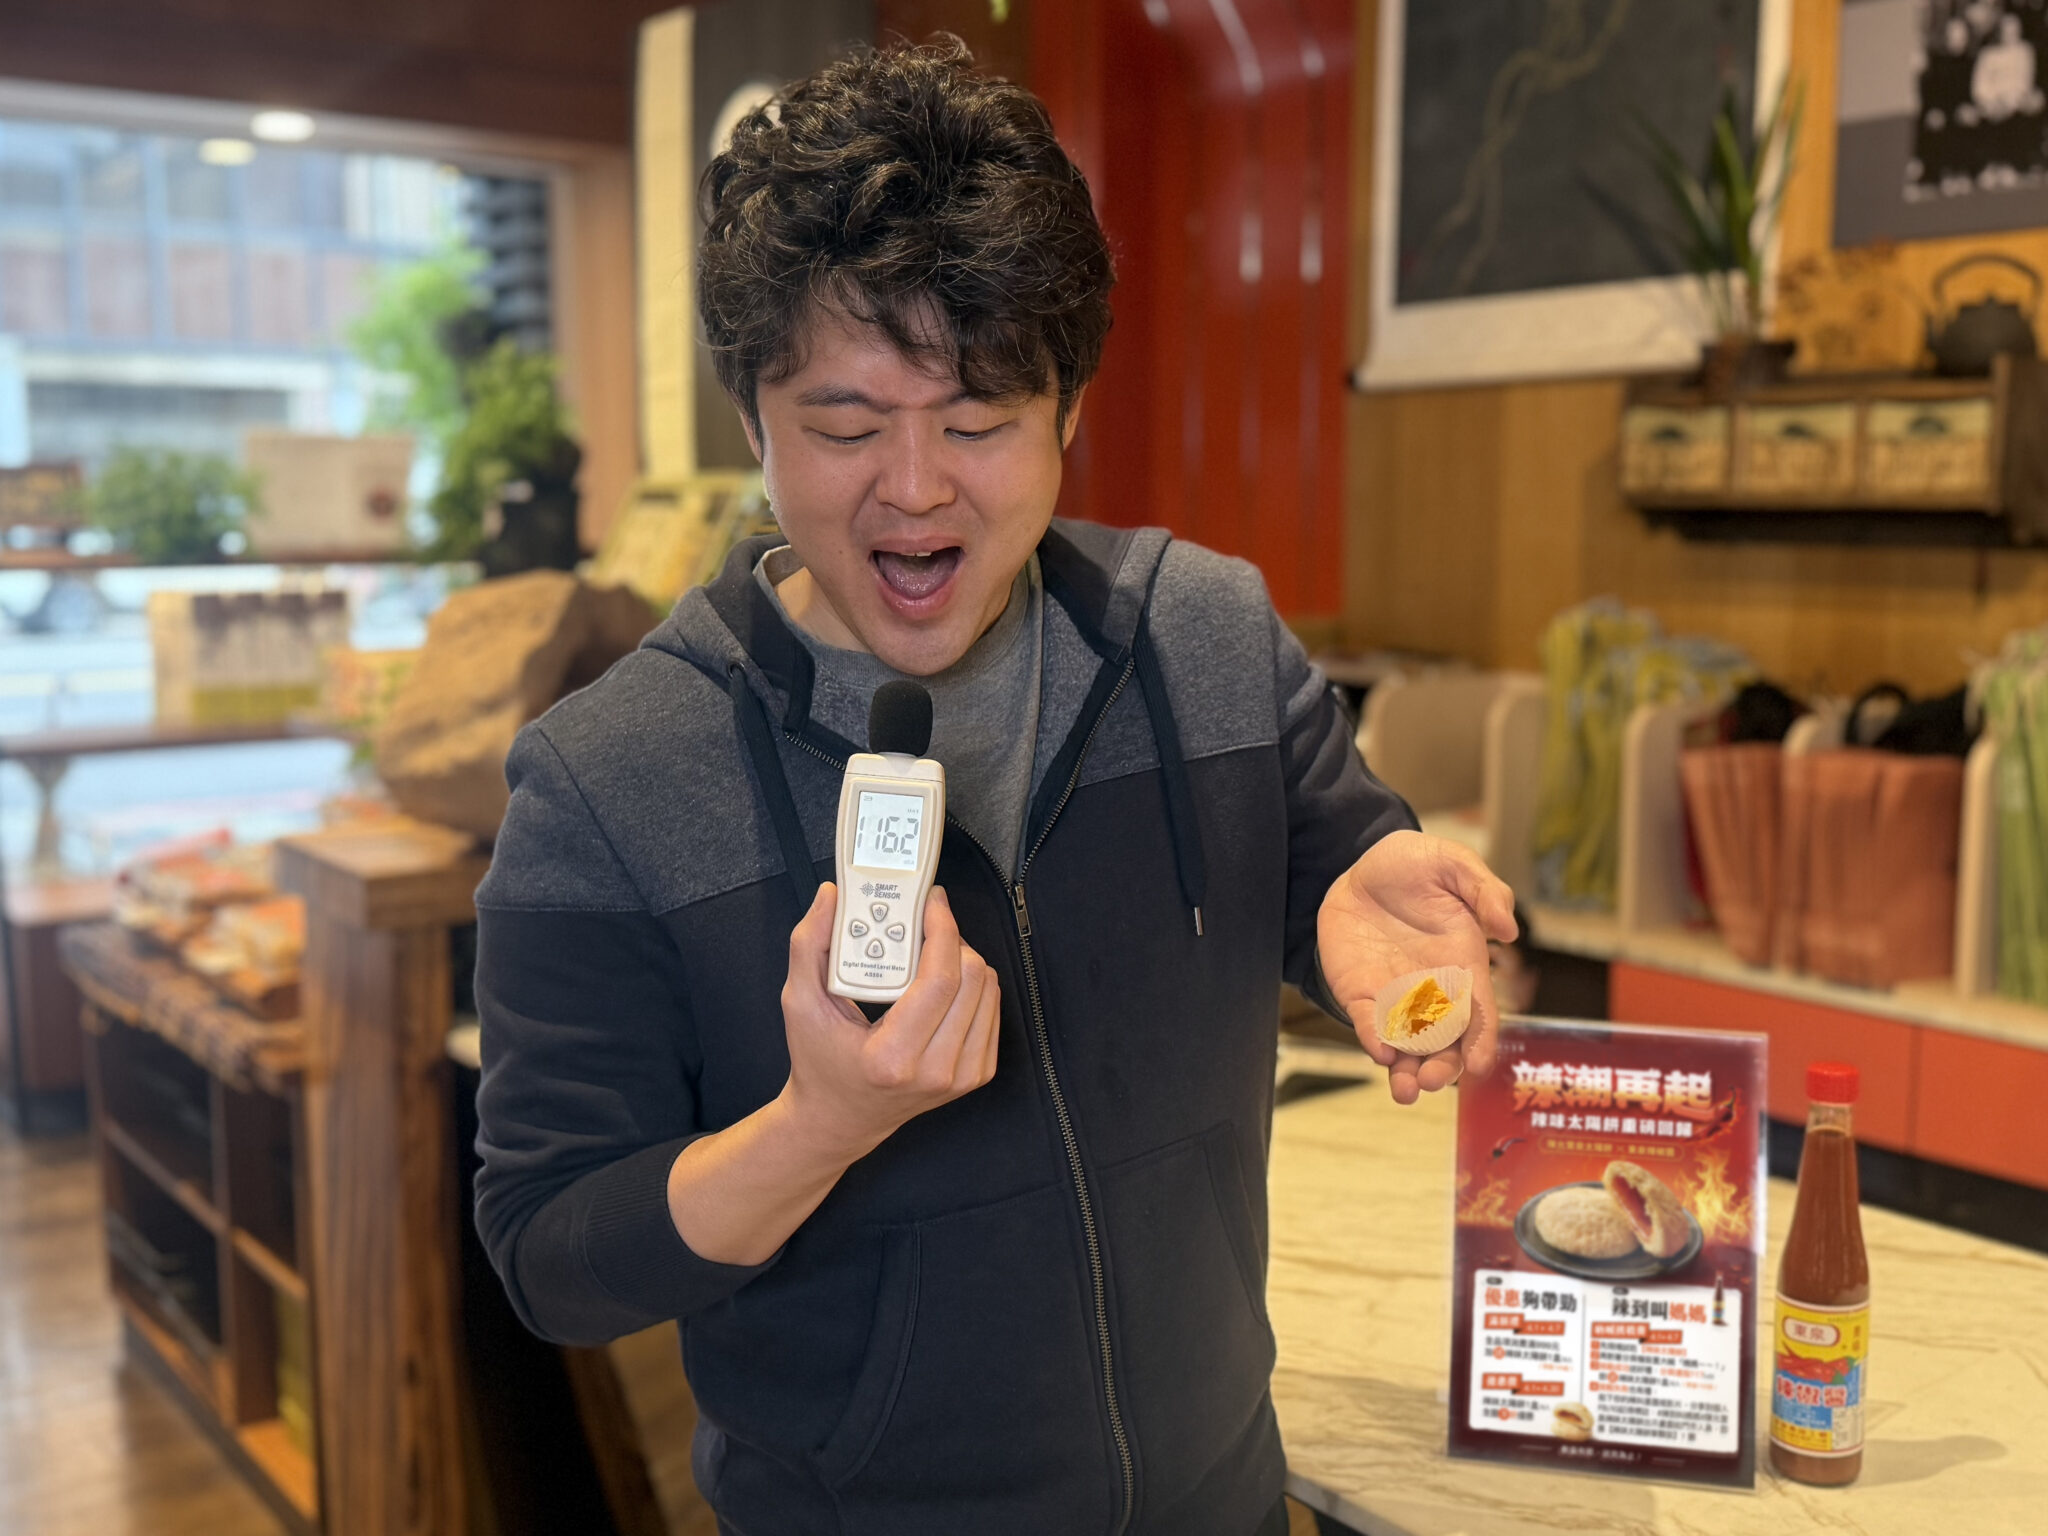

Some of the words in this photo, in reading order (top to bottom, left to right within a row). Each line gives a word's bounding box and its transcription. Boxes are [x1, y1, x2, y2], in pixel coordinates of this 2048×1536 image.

[874, 883, 898, 891] SMART
[874, 891, 901, 900] SENSOR
[842, 960, 860, 968] Digital
[1511, 1061, 1714, 1117] 辣潮再起
[1531, 1111, 1693, 1138] 辣味太陽餅重磅回歸
[1485, 1287, 1577, 1313] 優惠夠帶勁
[1612, 1298, 1707, 1324] 辣到叫媽媽
[1794, 1323, 1826, 1341] 東泉
[1776, 1374, 1848, 1408] 辣椒醬
